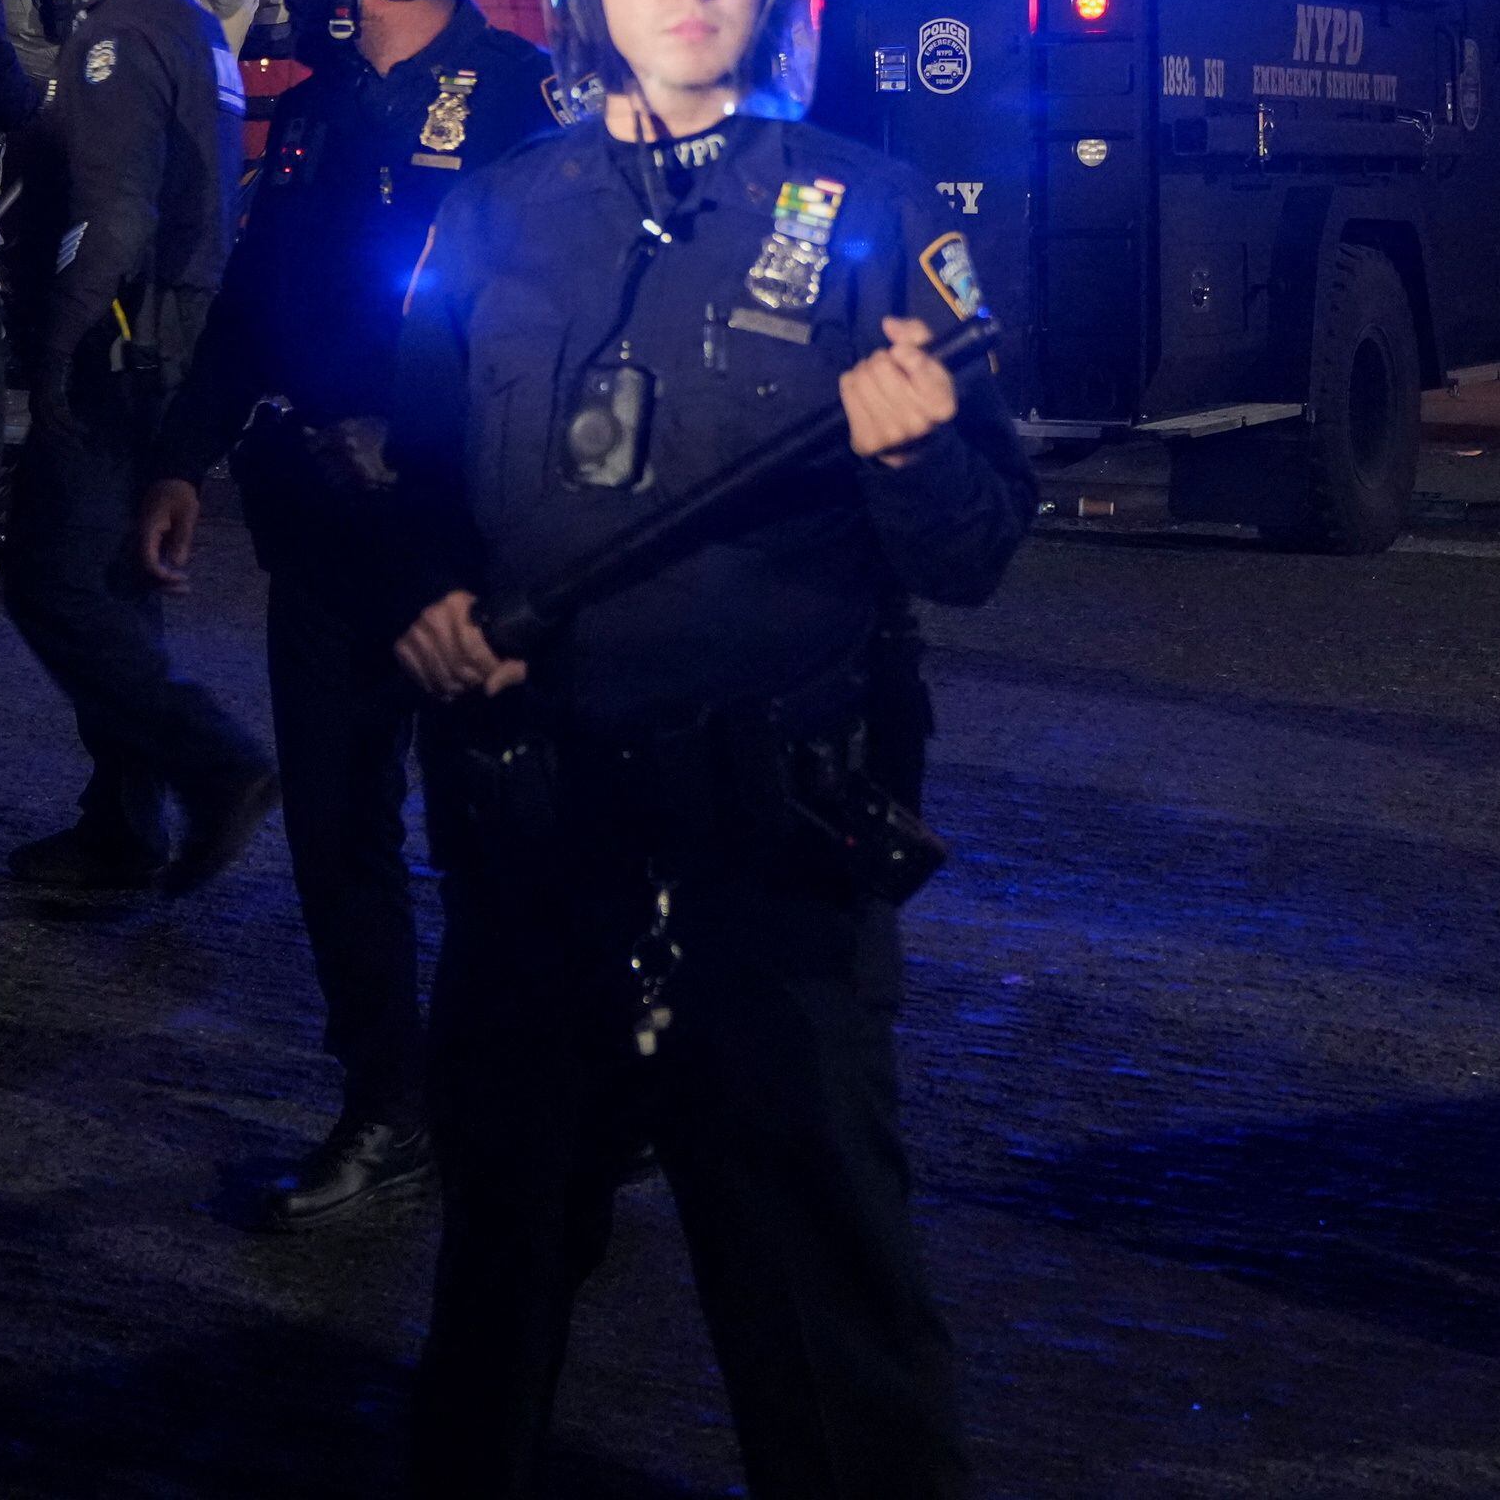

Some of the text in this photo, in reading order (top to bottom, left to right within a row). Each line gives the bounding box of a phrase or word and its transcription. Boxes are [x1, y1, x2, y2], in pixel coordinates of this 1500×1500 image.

[923, 22, 966, 44] POLICE
[924, 38, 965, 57] EMERGENCY
[1293, 3, 1364, 65] NYPD
[1204, 58, 1225, 98] ESU
[1252, 64, 1398, 101] EMERGENCY SERVICE UNIT
